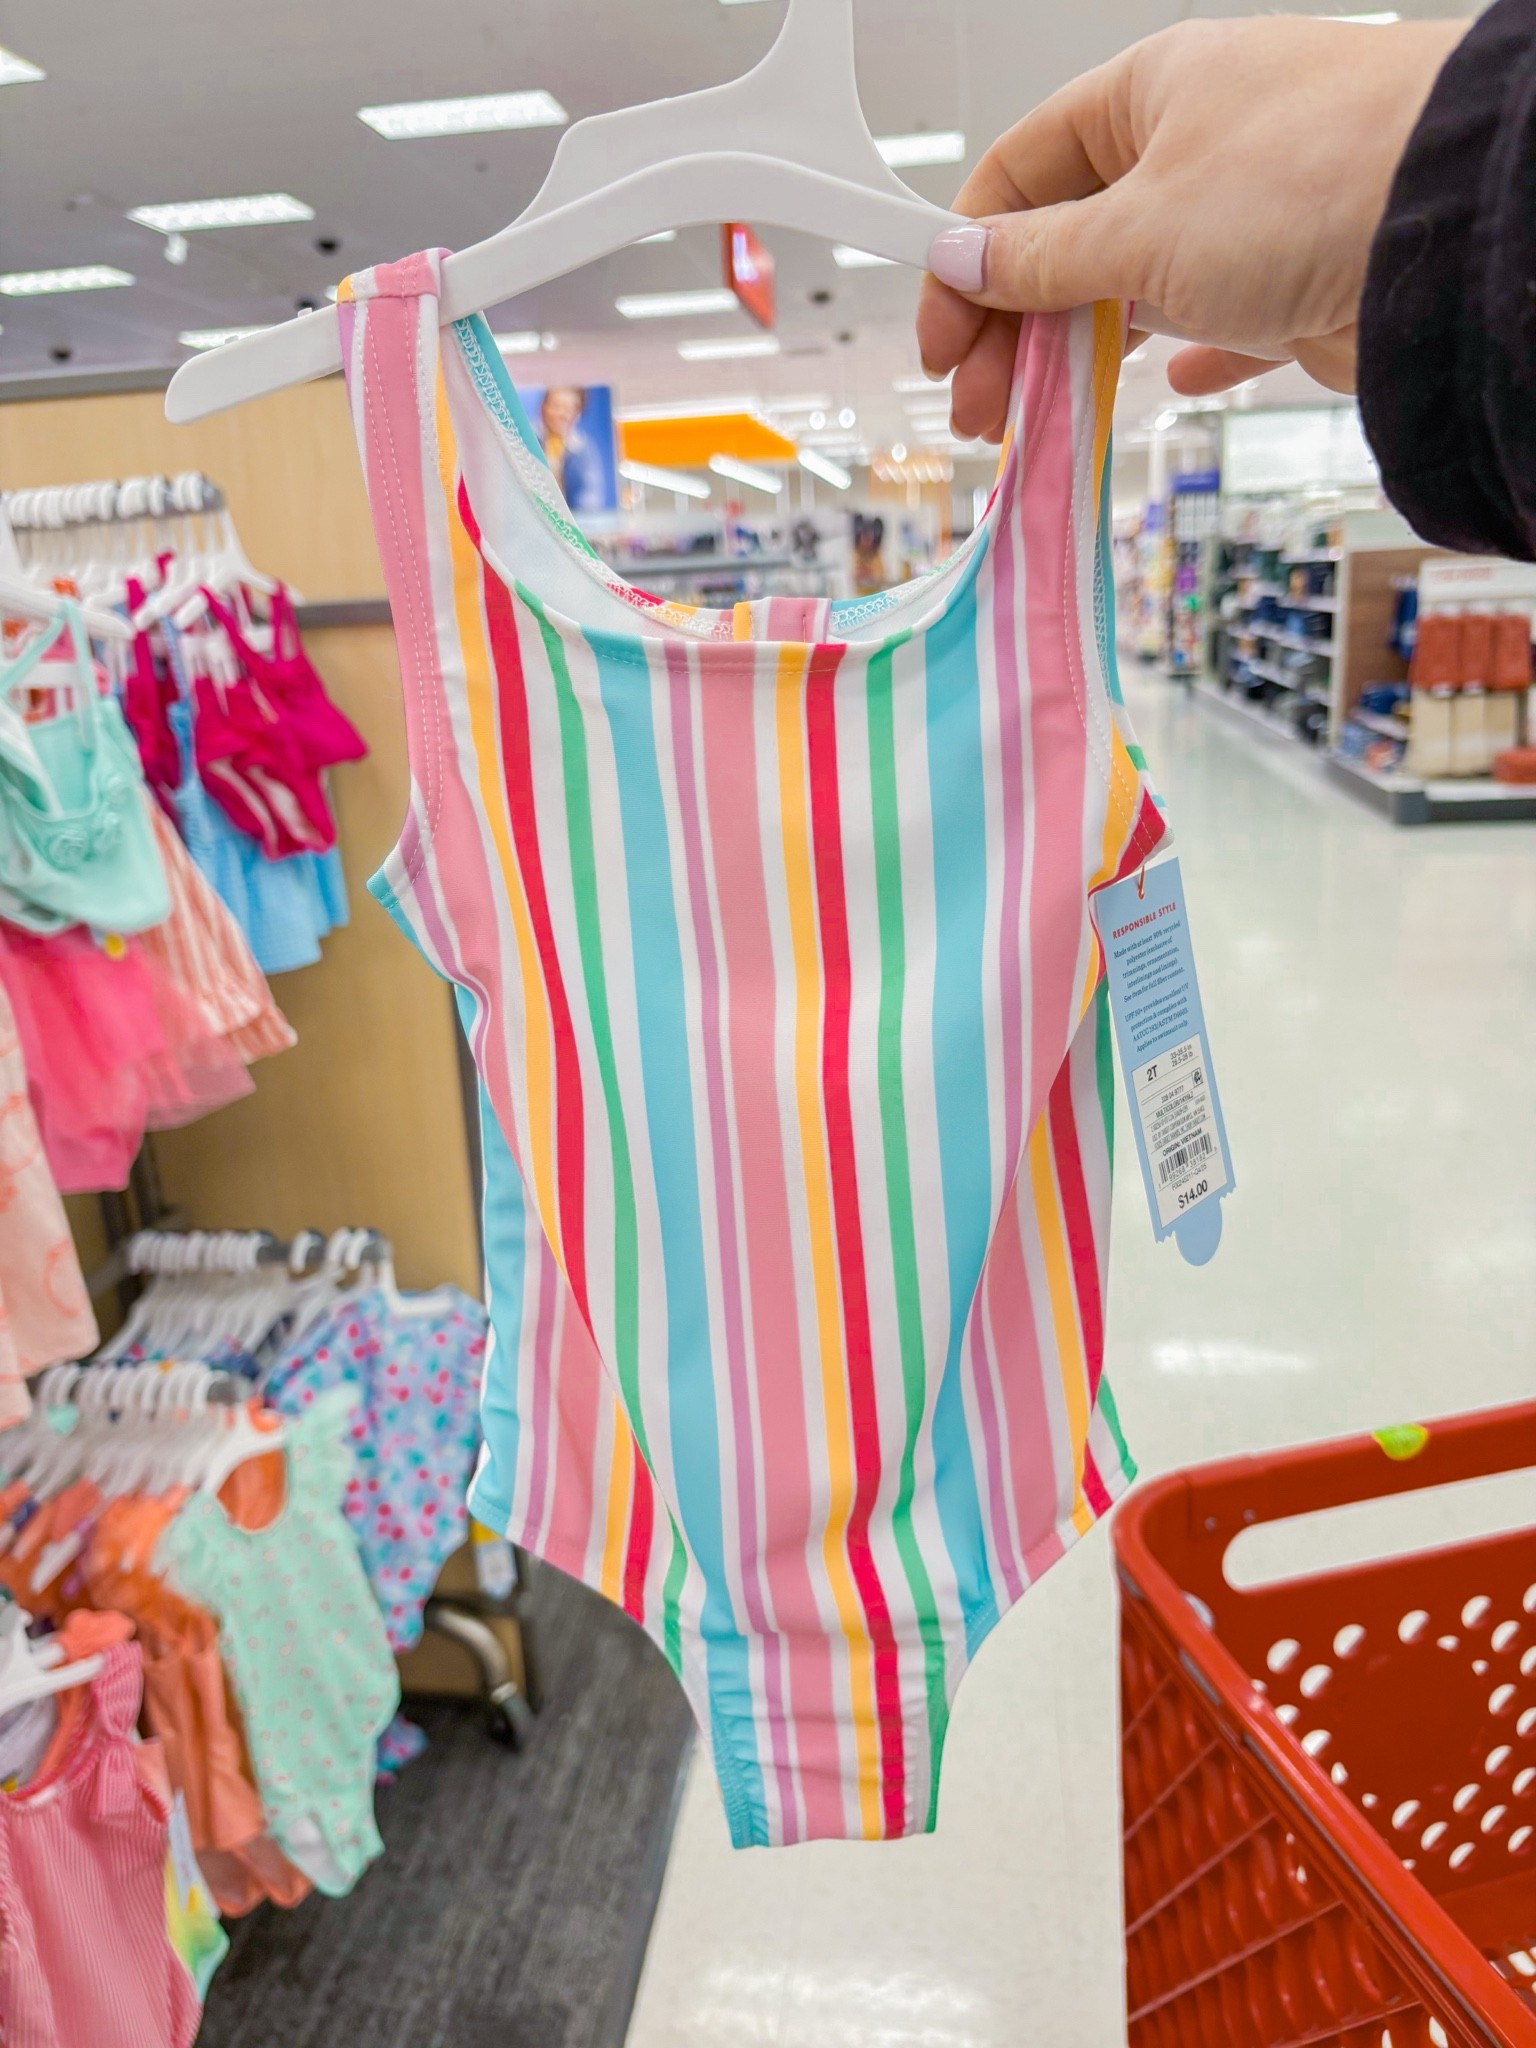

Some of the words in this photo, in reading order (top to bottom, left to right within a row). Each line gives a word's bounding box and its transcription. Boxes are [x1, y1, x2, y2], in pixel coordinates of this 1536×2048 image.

[1113, 912, 1156, 938] RESPONSIBLE
[1158, 902, 1176, 916] STYLE
[1114, 947, 1127, 959] Made
[1126, 950, 1146, 965] polyester
[1170, 1045, 1187, 1059] 33-35.5
[1146, 1065, 1159, 1081] 2T
[1162, 1140, 1180, 1156] ORIGIN:
[1181, 1126, 1202, 1145] VIETNAM
[1178, 1177, 1208, 1210] $14.00
